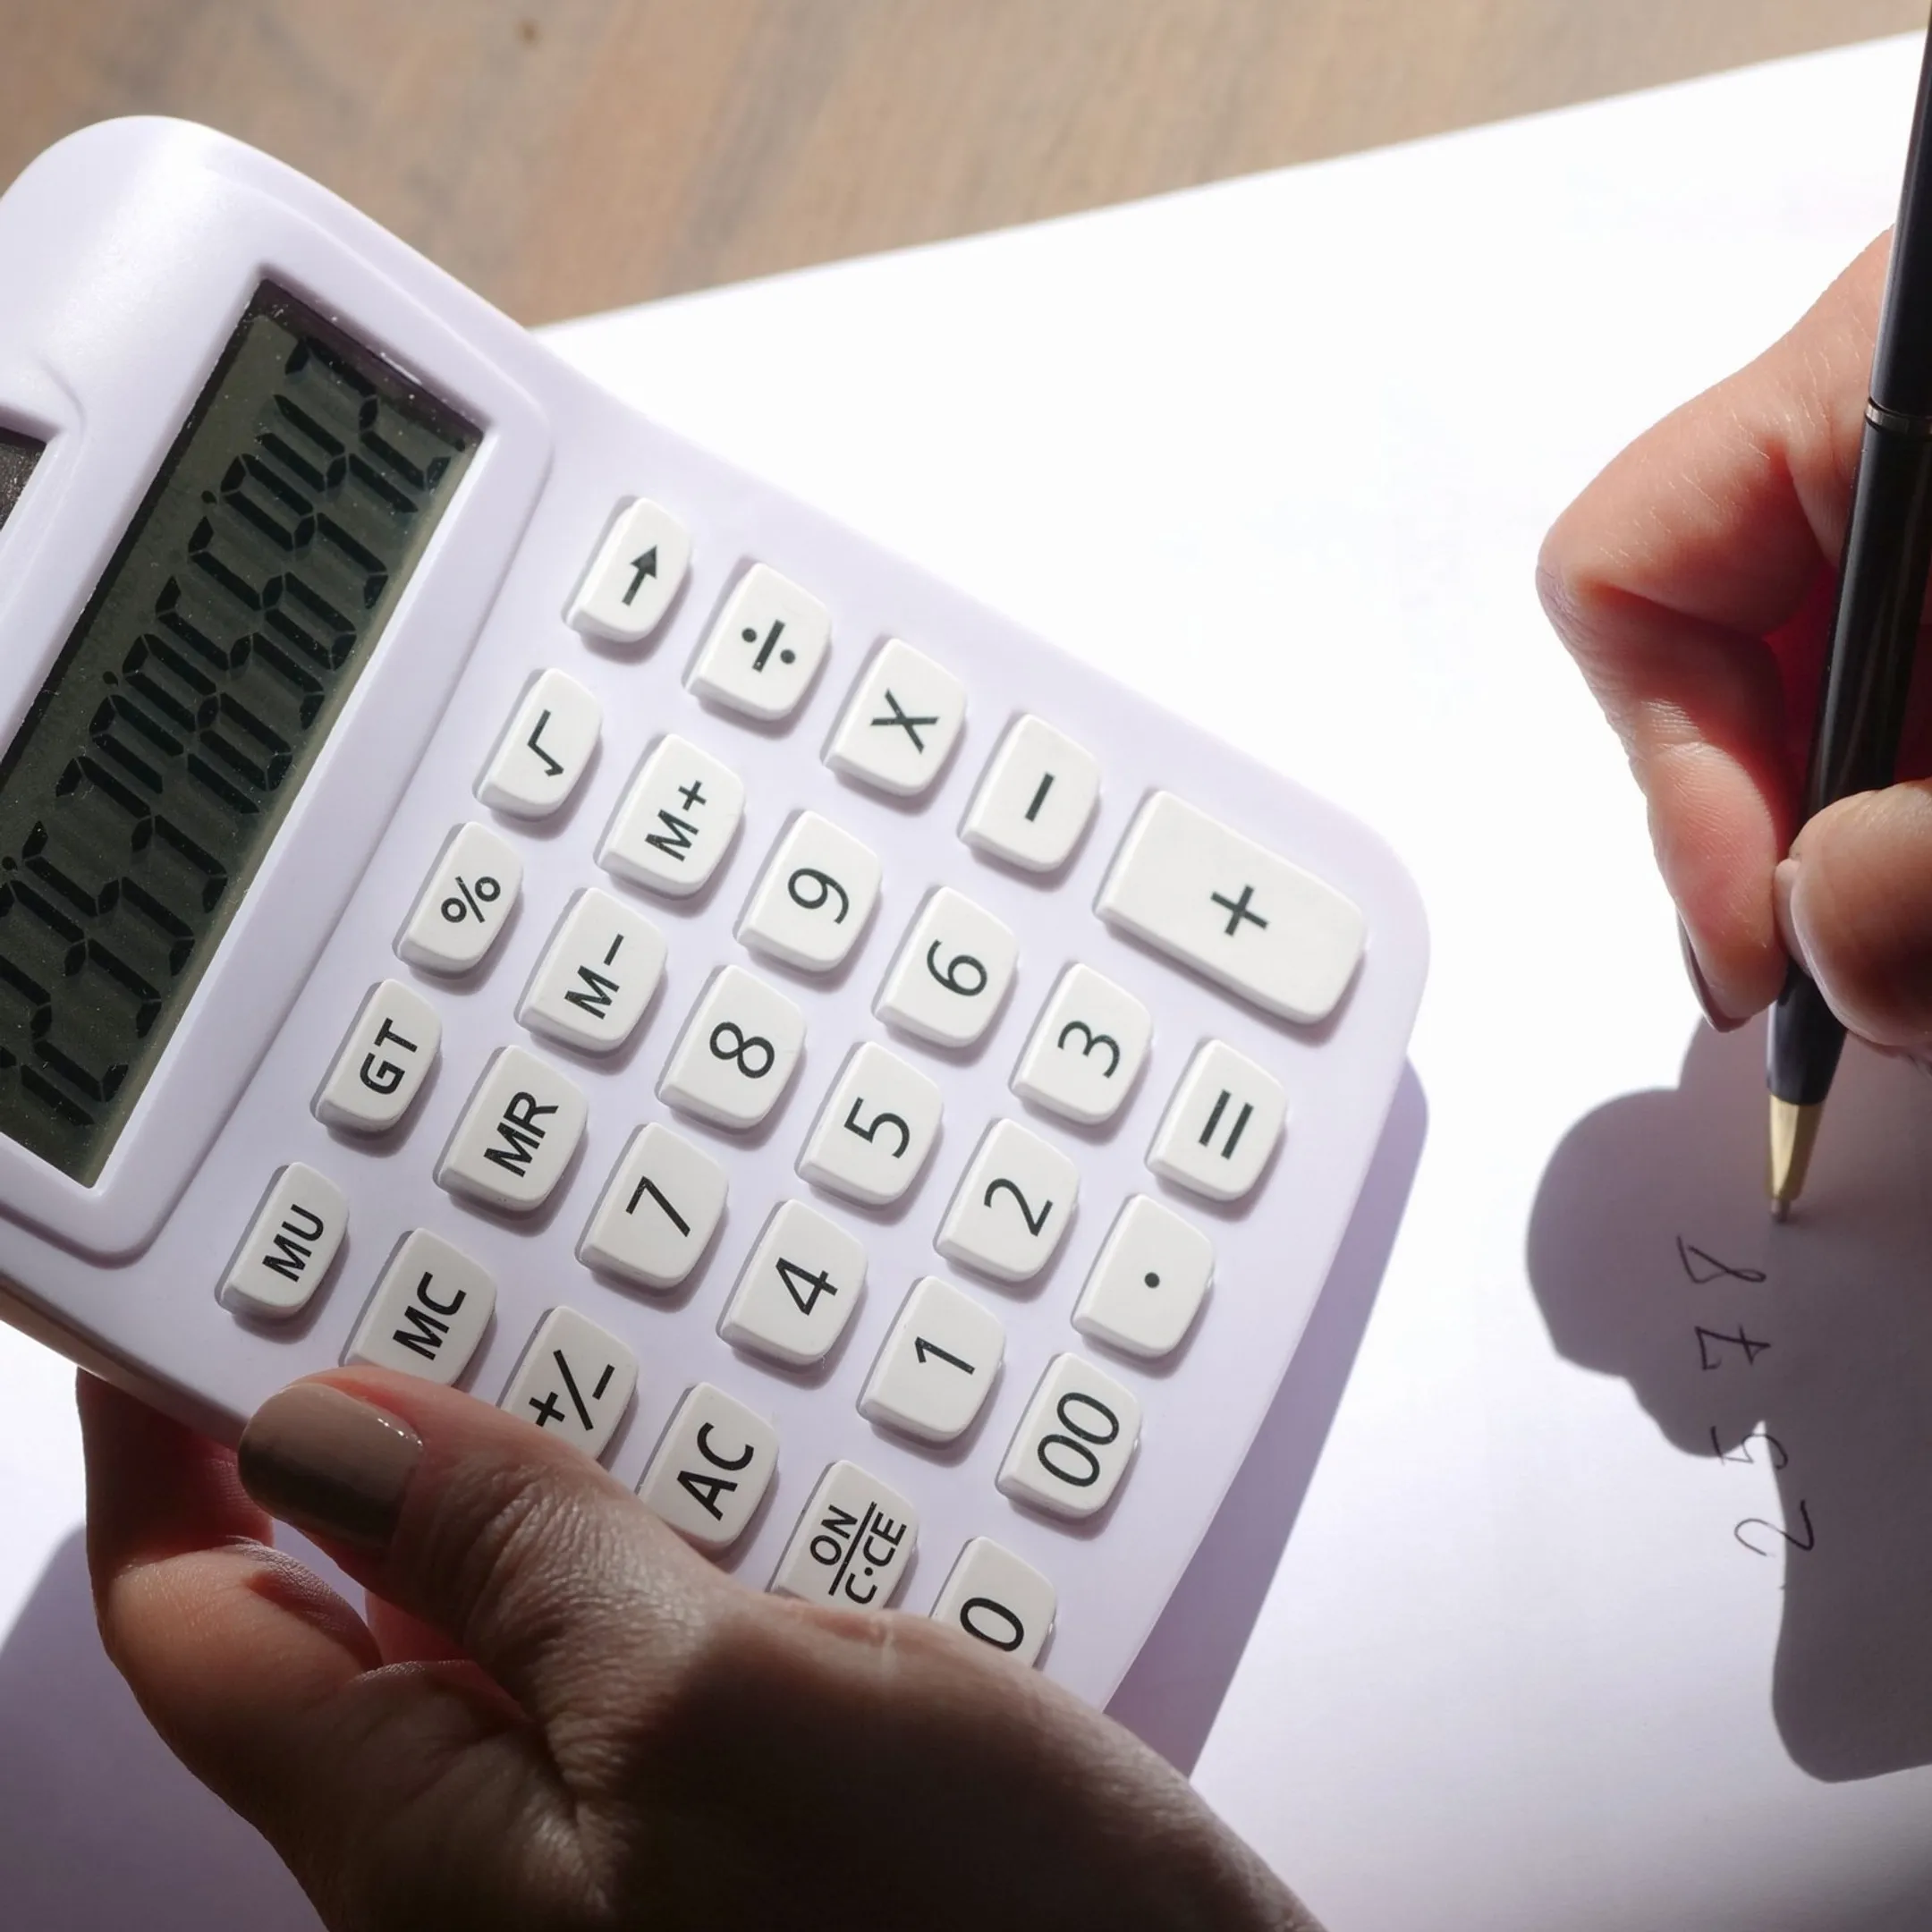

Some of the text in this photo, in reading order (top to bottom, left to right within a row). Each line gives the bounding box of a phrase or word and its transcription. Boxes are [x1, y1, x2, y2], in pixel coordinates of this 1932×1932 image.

[646, 782, 705, 860] M+
[441, 877, 500, 923] %
[789, 869, 848, 923] 9
[928, 941, 987, 996] 6
[360, 1018, 418, 1096] GT
[710, 1022, 775, 1078] 8
[1058, 1021, 1119, 1077] 3
[484, 1092, 558, 1177] MR
[844, 1098, 909, 1157] 5
[626, 1176, 691, 1237] 7
[985, 1179, 1052, 1236] 2
[263, 1204, 324, 1283] MU
[393, 1272, 466, 1360] MC
[775, 1258, 837, 1315] 4
[915, 1337, 975, 1374] 1
[1038, 1393, 1120, 1487] 00
[677, 1423, 755, 1521] AC
[810, 1505, 859, 1566] ON
